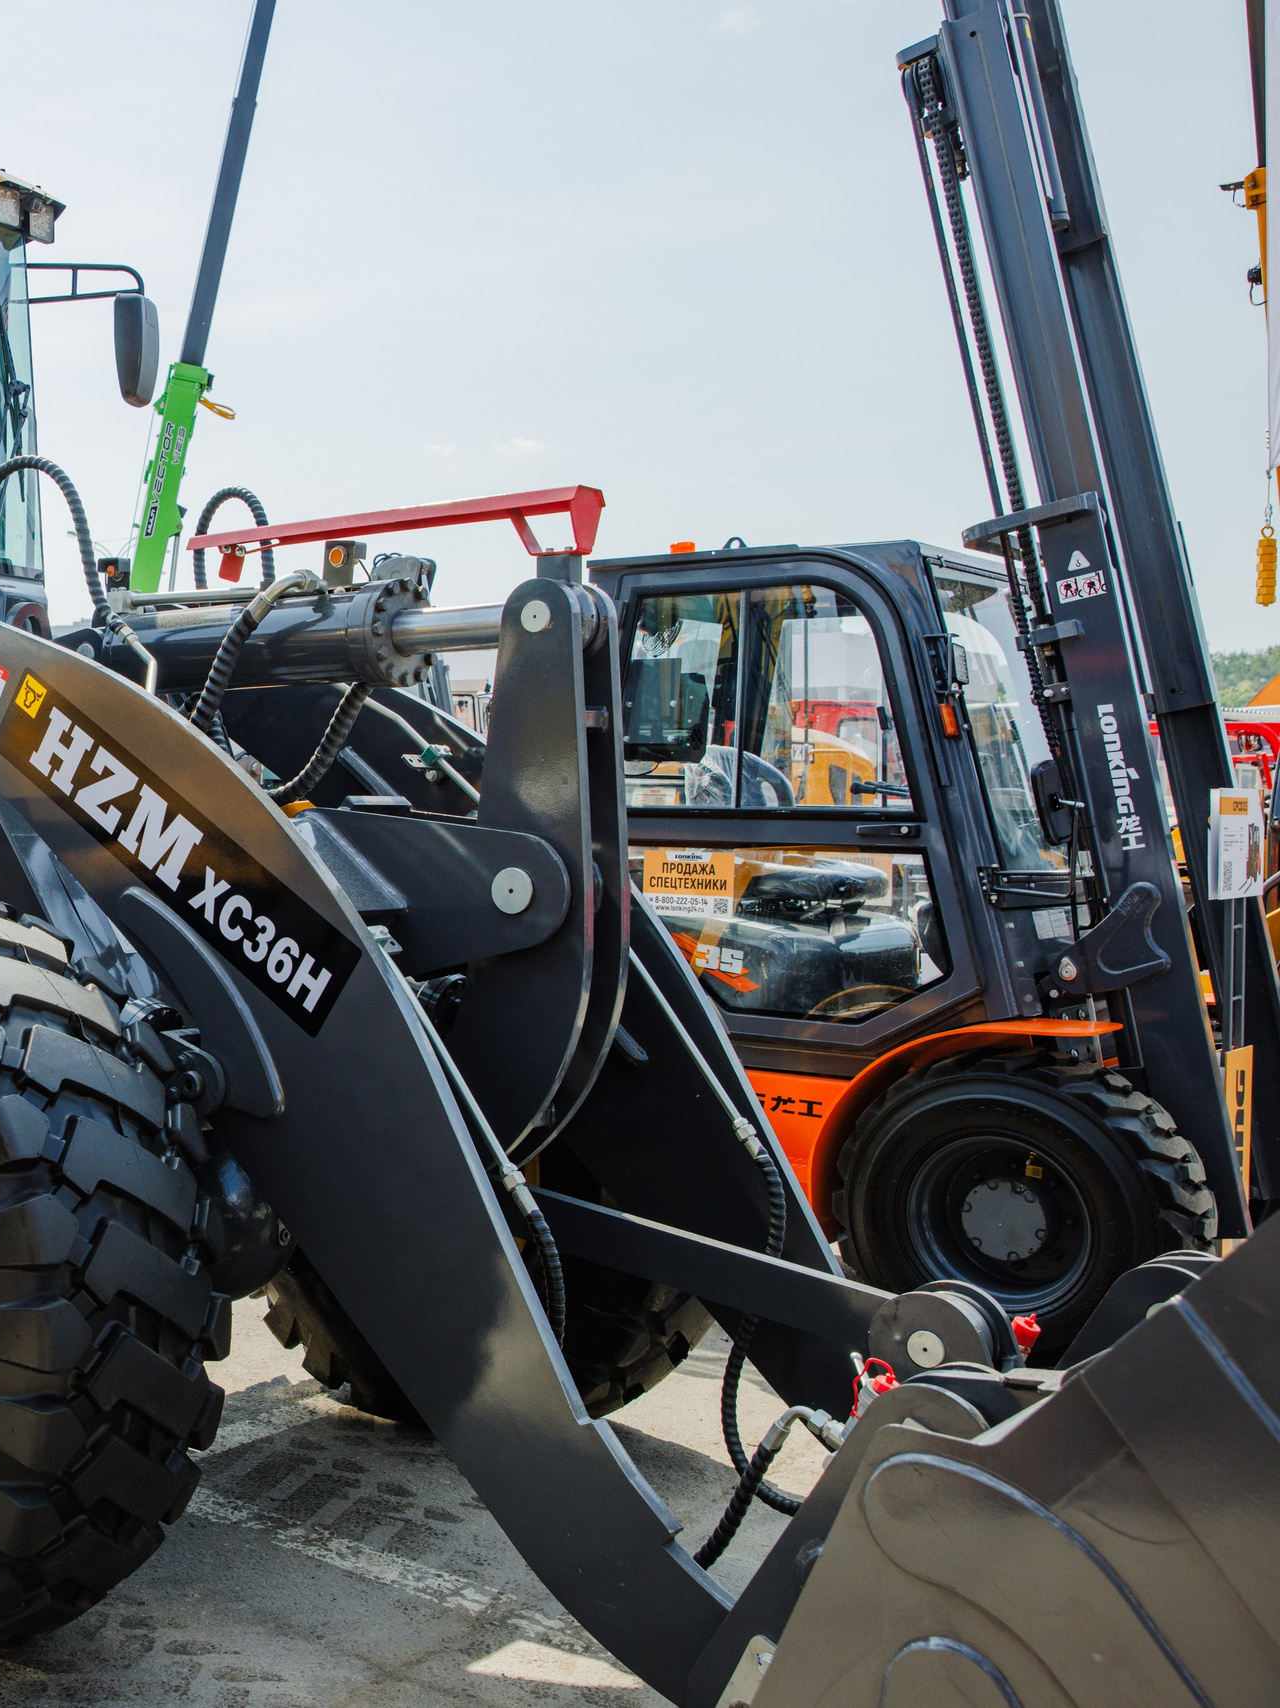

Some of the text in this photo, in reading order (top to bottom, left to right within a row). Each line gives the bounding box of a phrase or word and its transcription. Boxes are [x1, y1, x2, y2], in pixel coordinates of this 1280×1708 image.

[151, 421, 175, 505] VECTOR
[29, 706, 333, 1014] HZM XC36H
[662, 862, 716, 876] ПРОДАЖА
[649, 876, 727, 891] СПЕЦТЕХНИКИ
[654, 895, 708, 906] 8-800-222-05-14
[655, 904, 705, 913] www.lonking24.ru
[695, 943, 744, 975] 35
